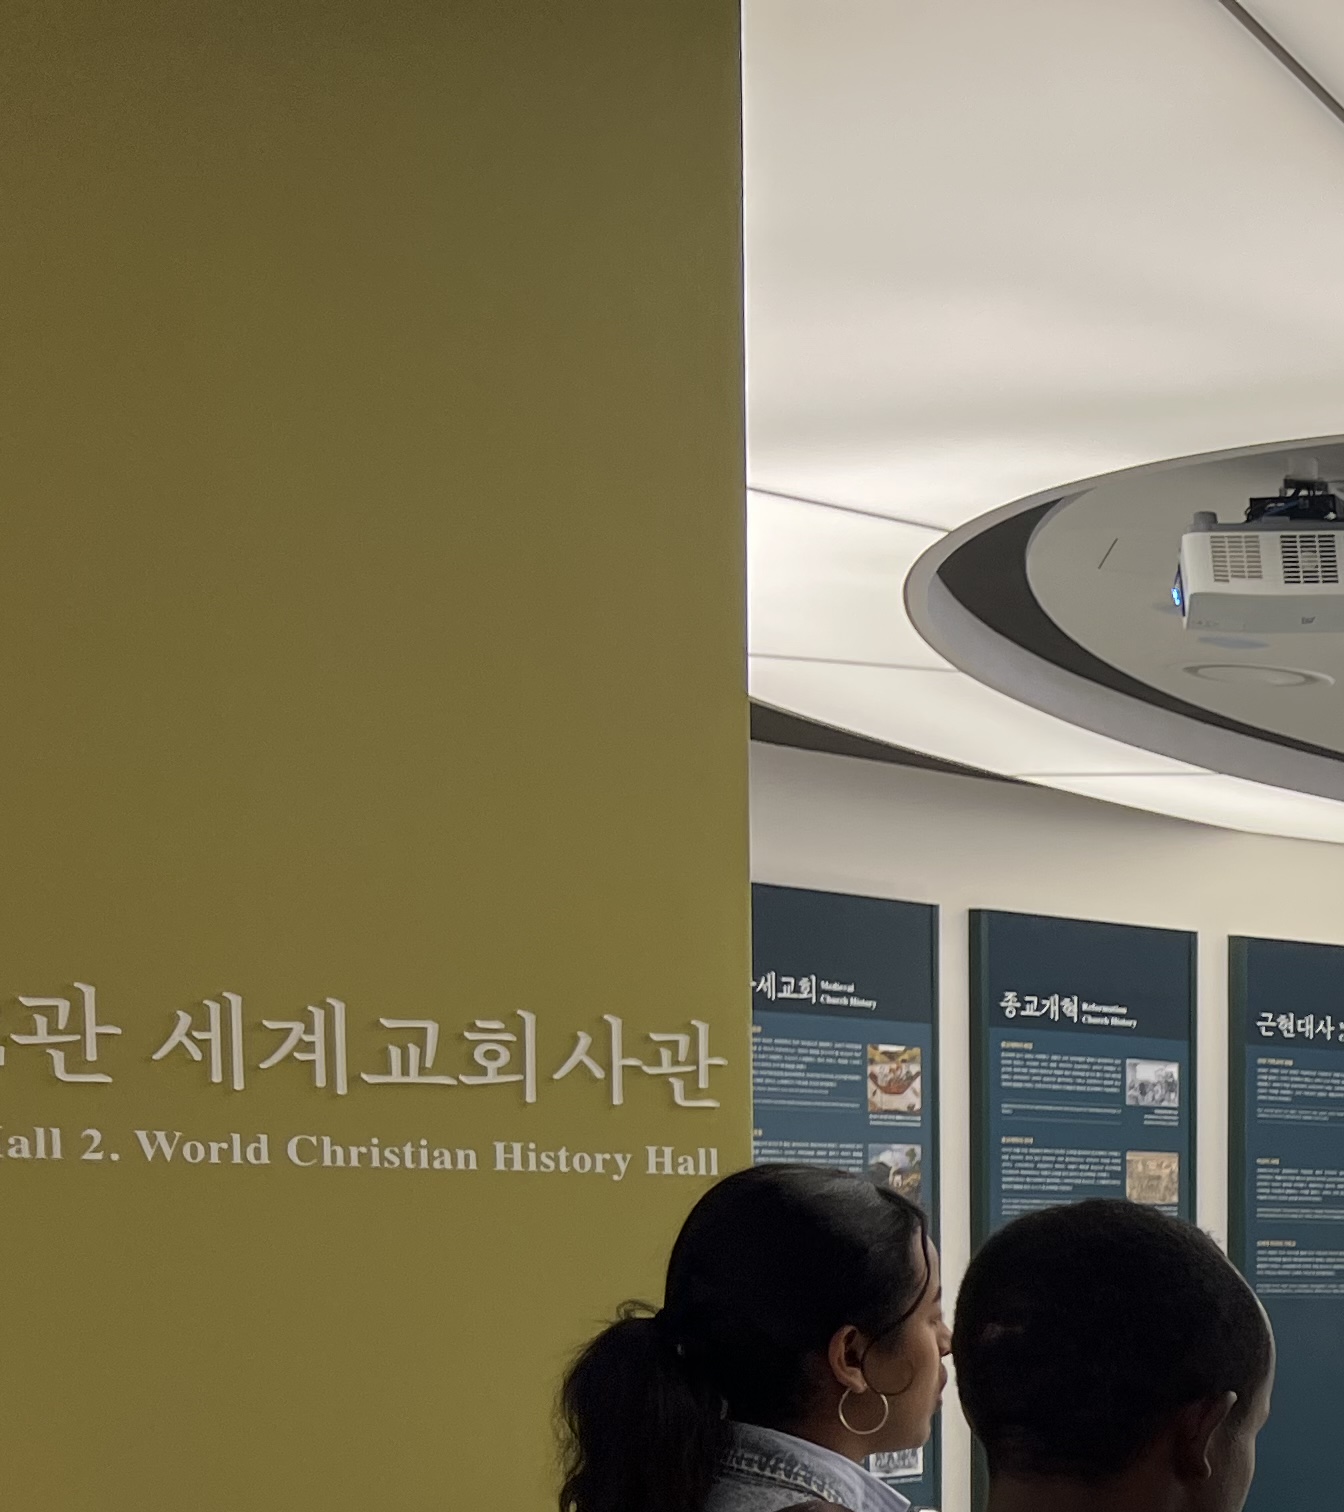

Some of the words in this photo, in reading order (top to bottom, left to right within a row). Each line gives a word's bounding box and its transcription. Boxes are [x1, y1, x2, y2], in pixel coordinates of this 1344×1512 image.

[999, 990, 1079, 1024] 종교개혁
[1256, 1010, 1336, 1042] 근현대사
[0, 981, 122, 1084] 관
[151, 991, 729, 1108] 세계교회사관
[0, 1126, 64, 1161] all
[80, 1128, 121, 1162] 2.
[134, 1129, 271, 1166] World
[286, 1134, 479, 1172] Christian
[493, 1141, 632, 1181] History
[644, 1145, 720, 1177] Hall
